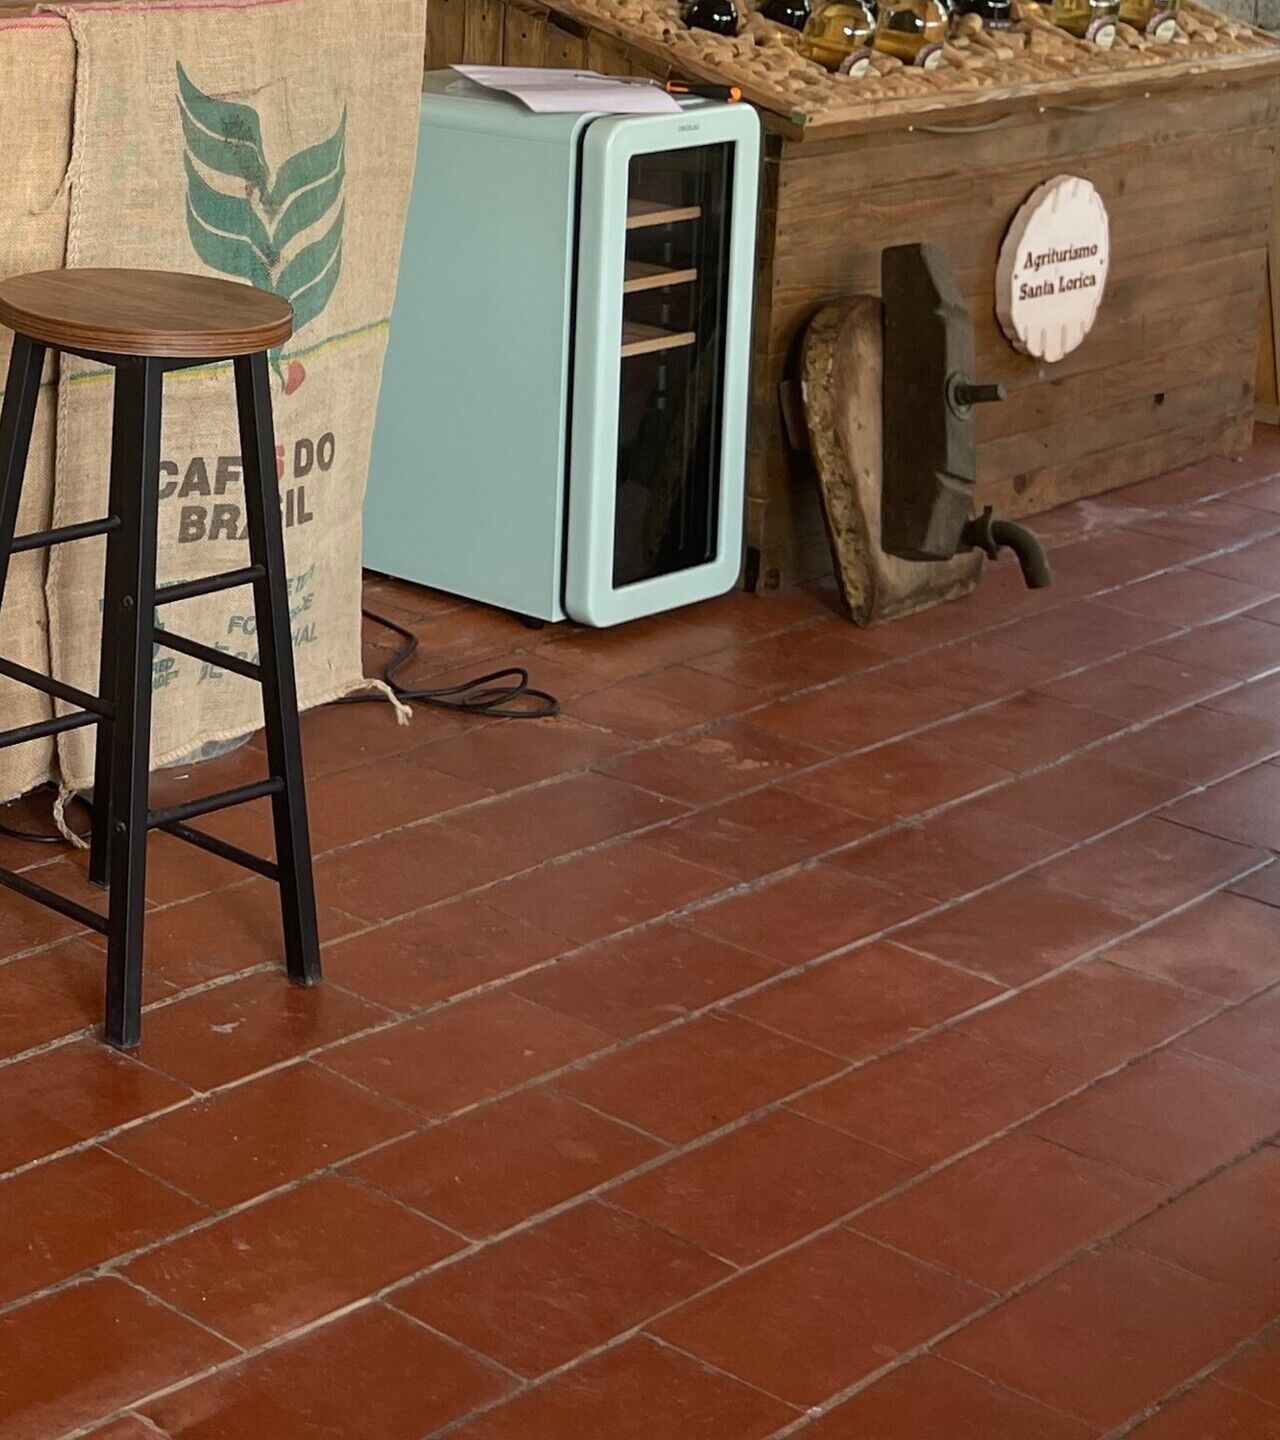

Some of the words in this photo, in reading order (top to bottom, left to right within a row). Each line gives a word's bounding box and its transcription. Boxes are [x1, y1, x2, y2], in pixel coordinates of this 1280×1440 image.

[1019, 280, 1054, 301] Santa
[1058, 271, 1097, 294] Lorica
[293, 432, 335, 479] DO
